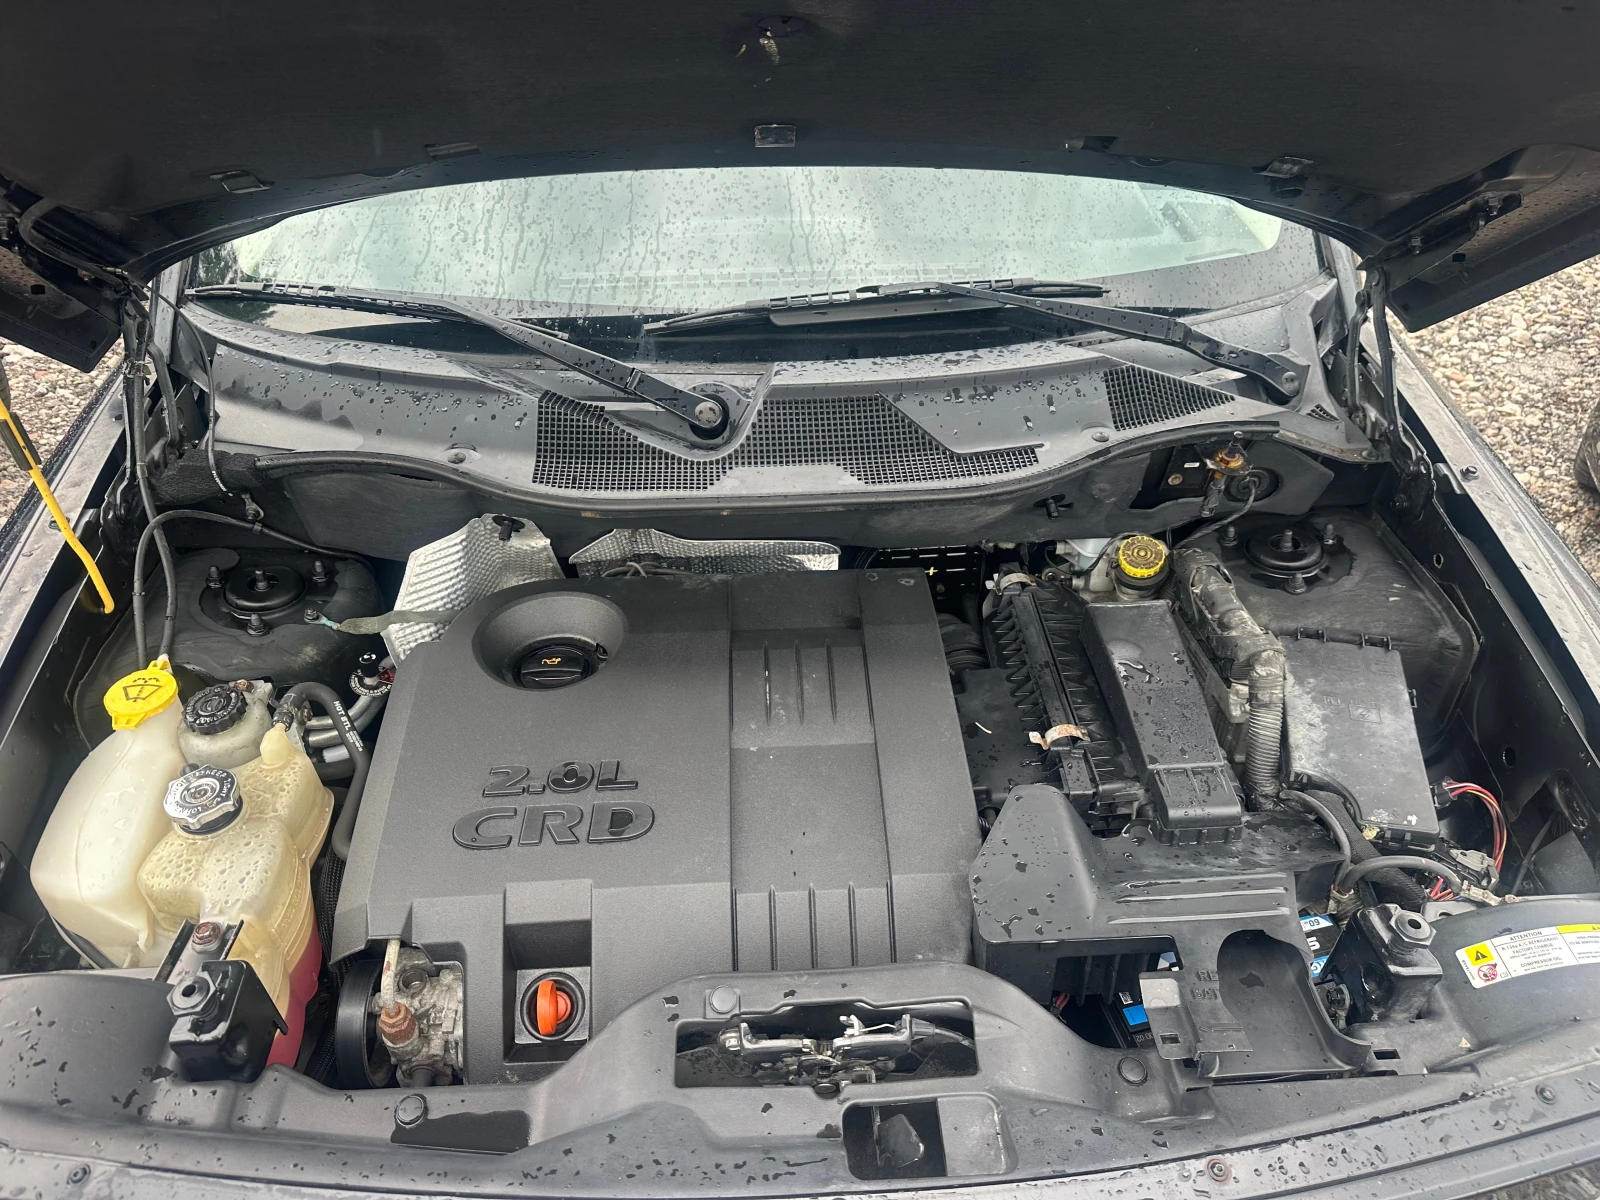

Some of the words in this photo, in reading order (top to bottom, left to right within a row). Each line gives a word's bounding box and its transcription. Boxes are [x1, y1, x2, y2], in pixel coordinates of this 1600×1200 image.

[333, 700, 345, 715] HOT
[340, 715, 352, 731] BTL
[482, 760, 639, 798] 2.0L
[452, 801, 656, 851] CRD
[1509, 931, 1543, 941] ATTENTION
[1528, 936, 1559, 946] REFRIGERANT
[1512, 947, 1534, 955] FACTORY
[1520, 957, 1553, 968] COMPRESSOR
